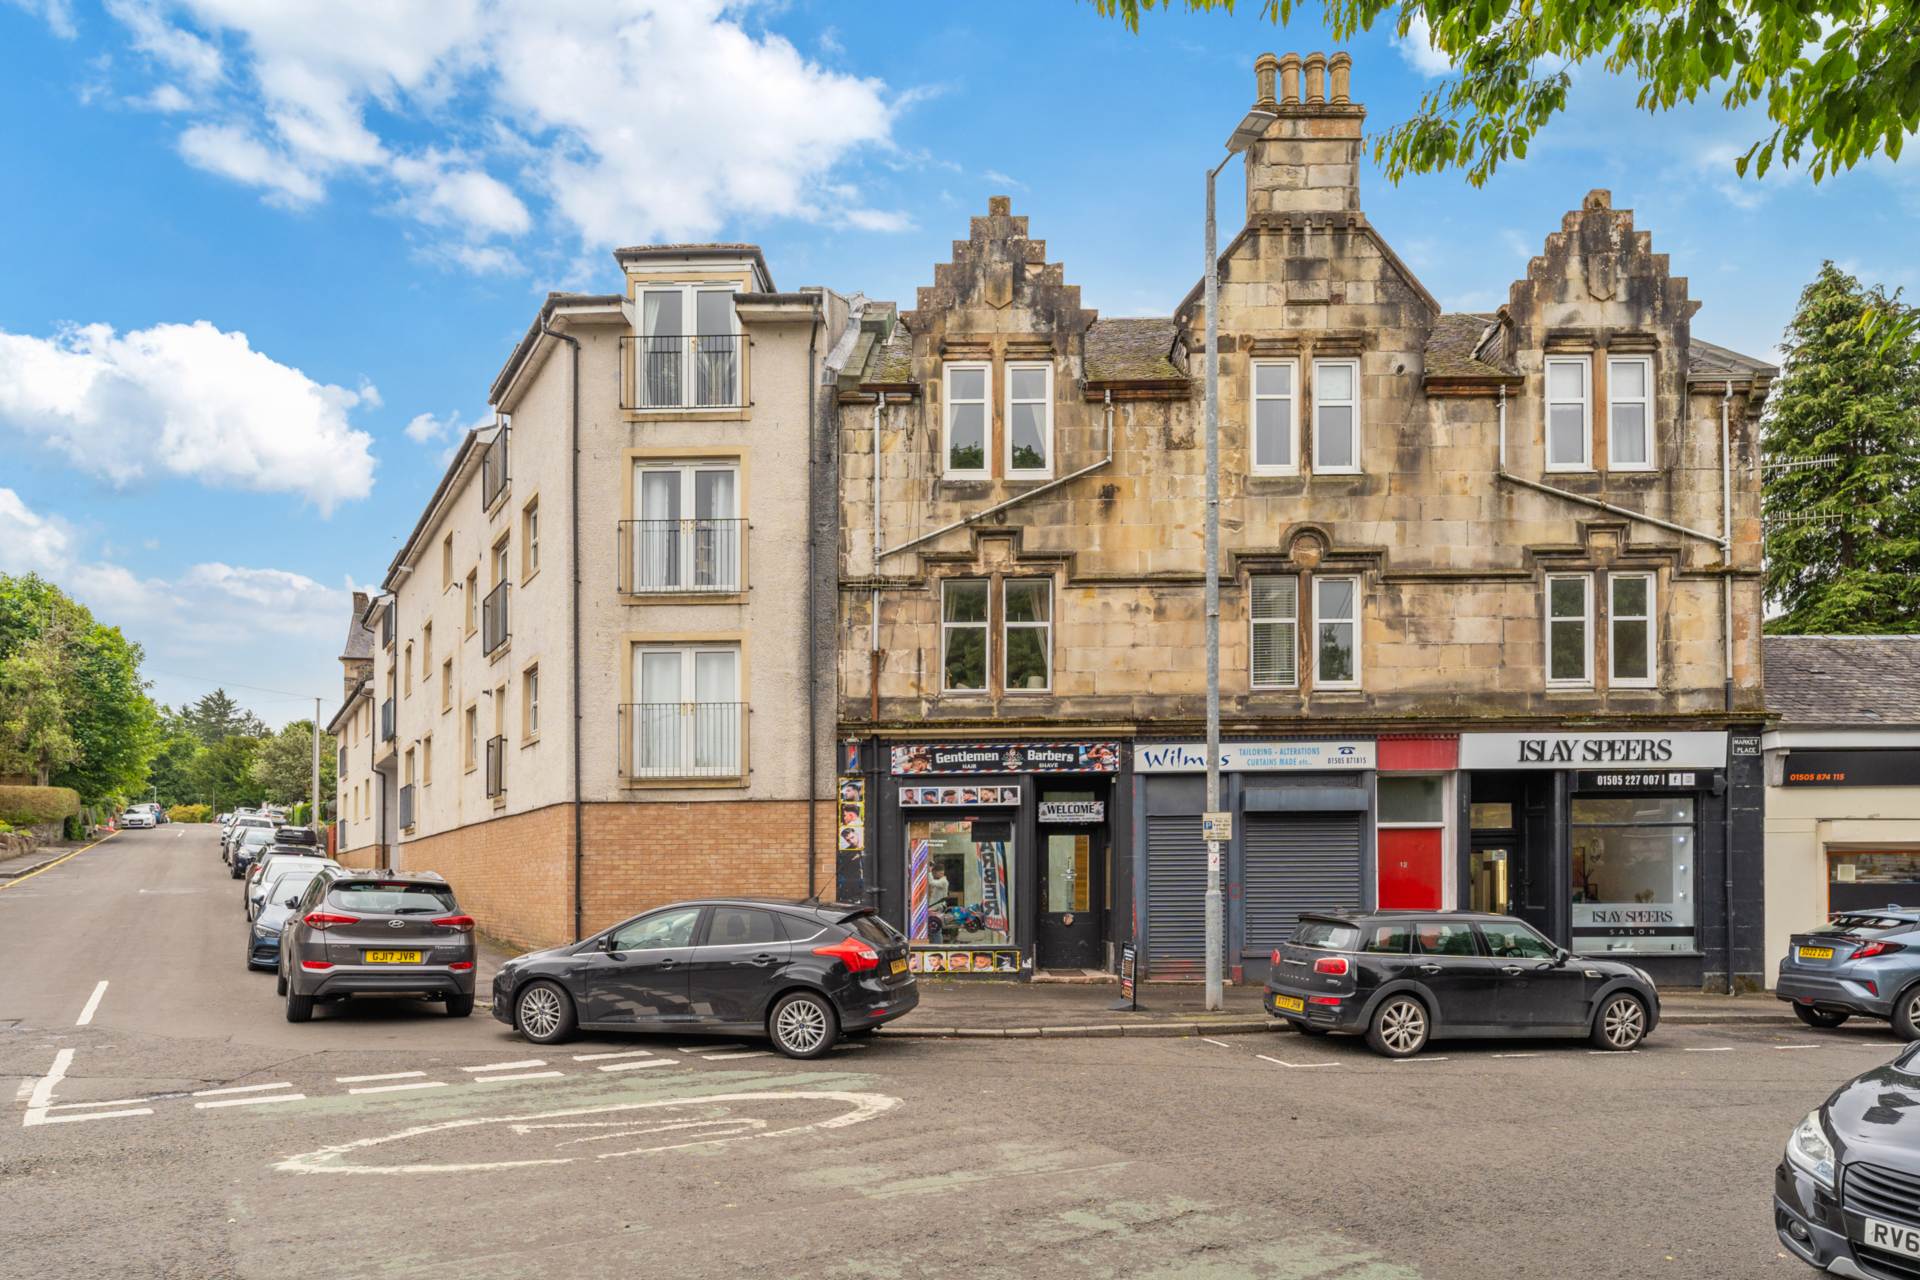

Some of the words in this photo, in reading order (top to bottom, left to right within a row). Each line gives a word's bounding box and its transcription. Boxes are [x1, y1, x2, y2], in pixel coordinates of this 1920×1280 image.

[1239, 747, 1273, 756] TAILORING
[1280, 746, 1320, 755] ALTERATIONS
[1518, 739, 1579, 762] ISLAY
[1583, 739, 1672, 762] SPEERS
[935, 751, 999, 764] Gentlemen
[1027, 749, 1074, 762] Barbers
[1144, 747, 1231, 768] Wilms
[1247, 758, 1278, 766] CURTAINS
[1279, 758, 1297, 766] MADE
[1327, 757, 1345, 765] 01505
[1597, 775, 1623, 786] 01505
[1625, 775, 1641, 785] 227
[1643, 774, 1659, 785] 007
[1790, 773, 1815, 781] 01505
[1833, 773, 1845, 781] 115
[1047, 804, 1095, 814] WELCOME
[980, 841, 1000, 915] ARBER
[1592, 911, 1624, 923] ISLAY
[1625, 910, 1673, 922] SPEERS
[372, 952, 395, 961] GJ17
[396, 952, 416, 961] JVR
